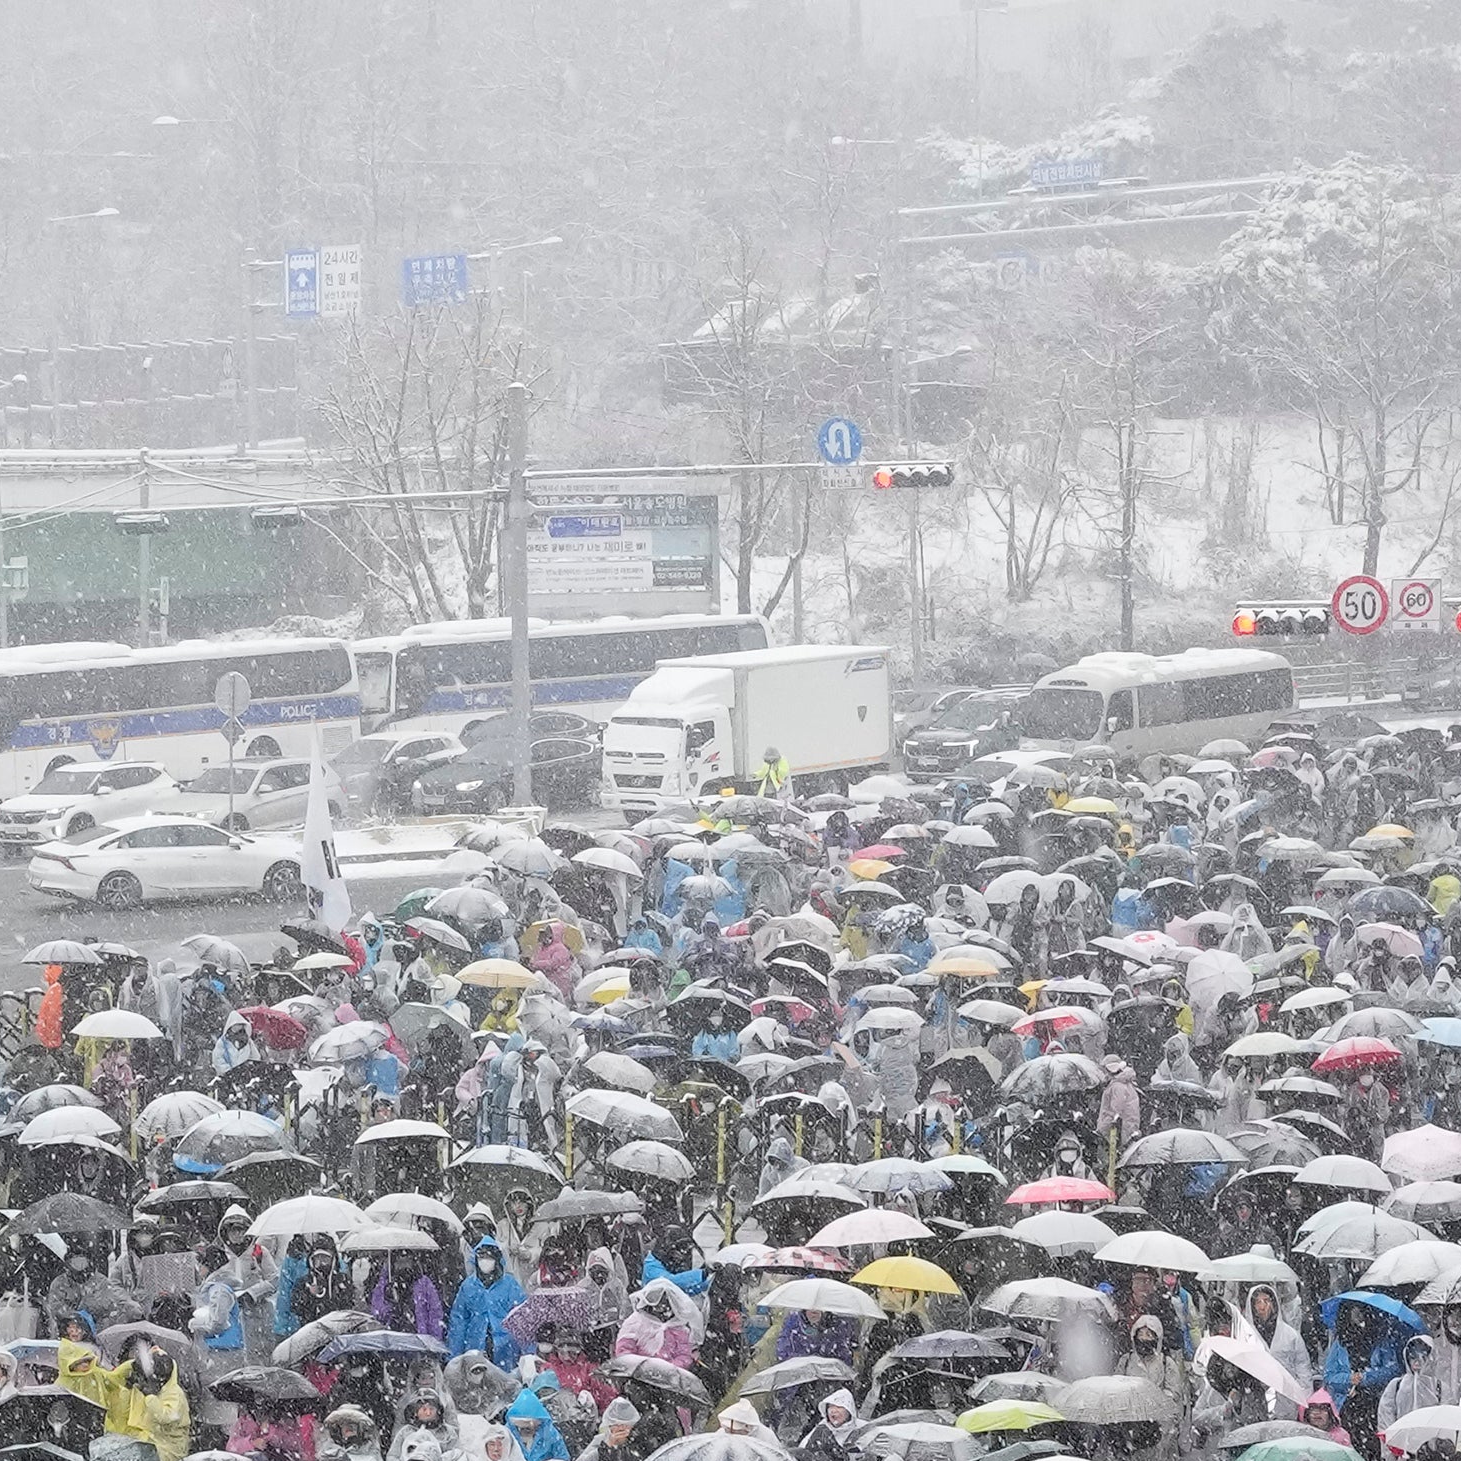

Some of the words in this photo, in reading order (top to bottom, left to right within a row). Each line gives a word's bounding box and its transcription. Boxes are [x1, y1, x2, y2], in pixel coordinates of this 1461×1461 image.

[324, 250, 359, 265] 24시간
[1344, 591, 1377, 621] 50
[1406, 592, 1427, 608] 60
[280, 704, 317, 719] POLICE
[47, 726, 71, 740] 경찰
